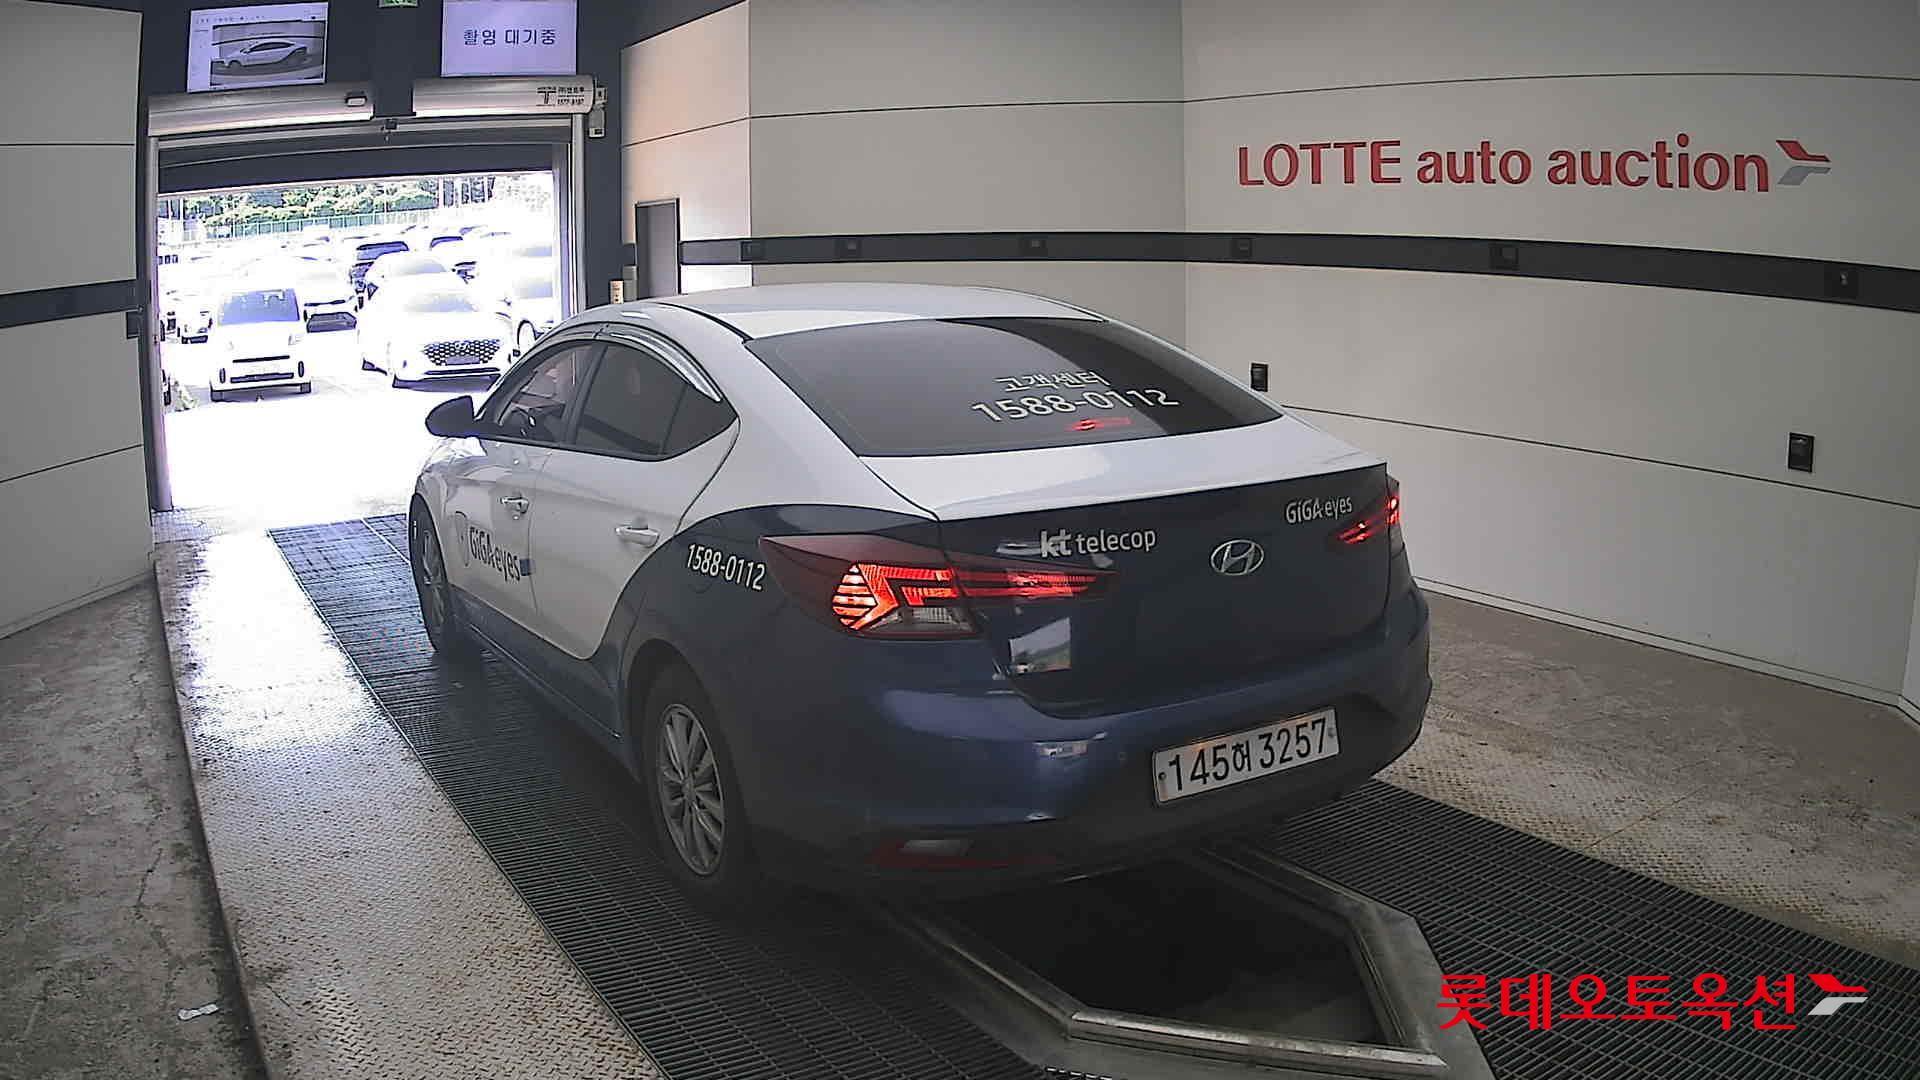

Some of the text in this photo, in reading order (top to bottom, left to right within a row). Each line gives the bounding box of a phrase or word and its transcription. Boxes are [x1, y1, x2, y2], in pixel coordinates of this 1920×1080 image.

[504, 29, 556, 46] 대기중
[1239, 133, 1769, 192] LOTTE auto auction
[995, 371, 1110, 392] 고객센터
[971, 388, 1179, 421] 1588-0112
[1040, 528, 1157, 558] kt telecop
[686, 543, 767, 592] 1588-0112
[1258, 717, 1326, 769] 3257
